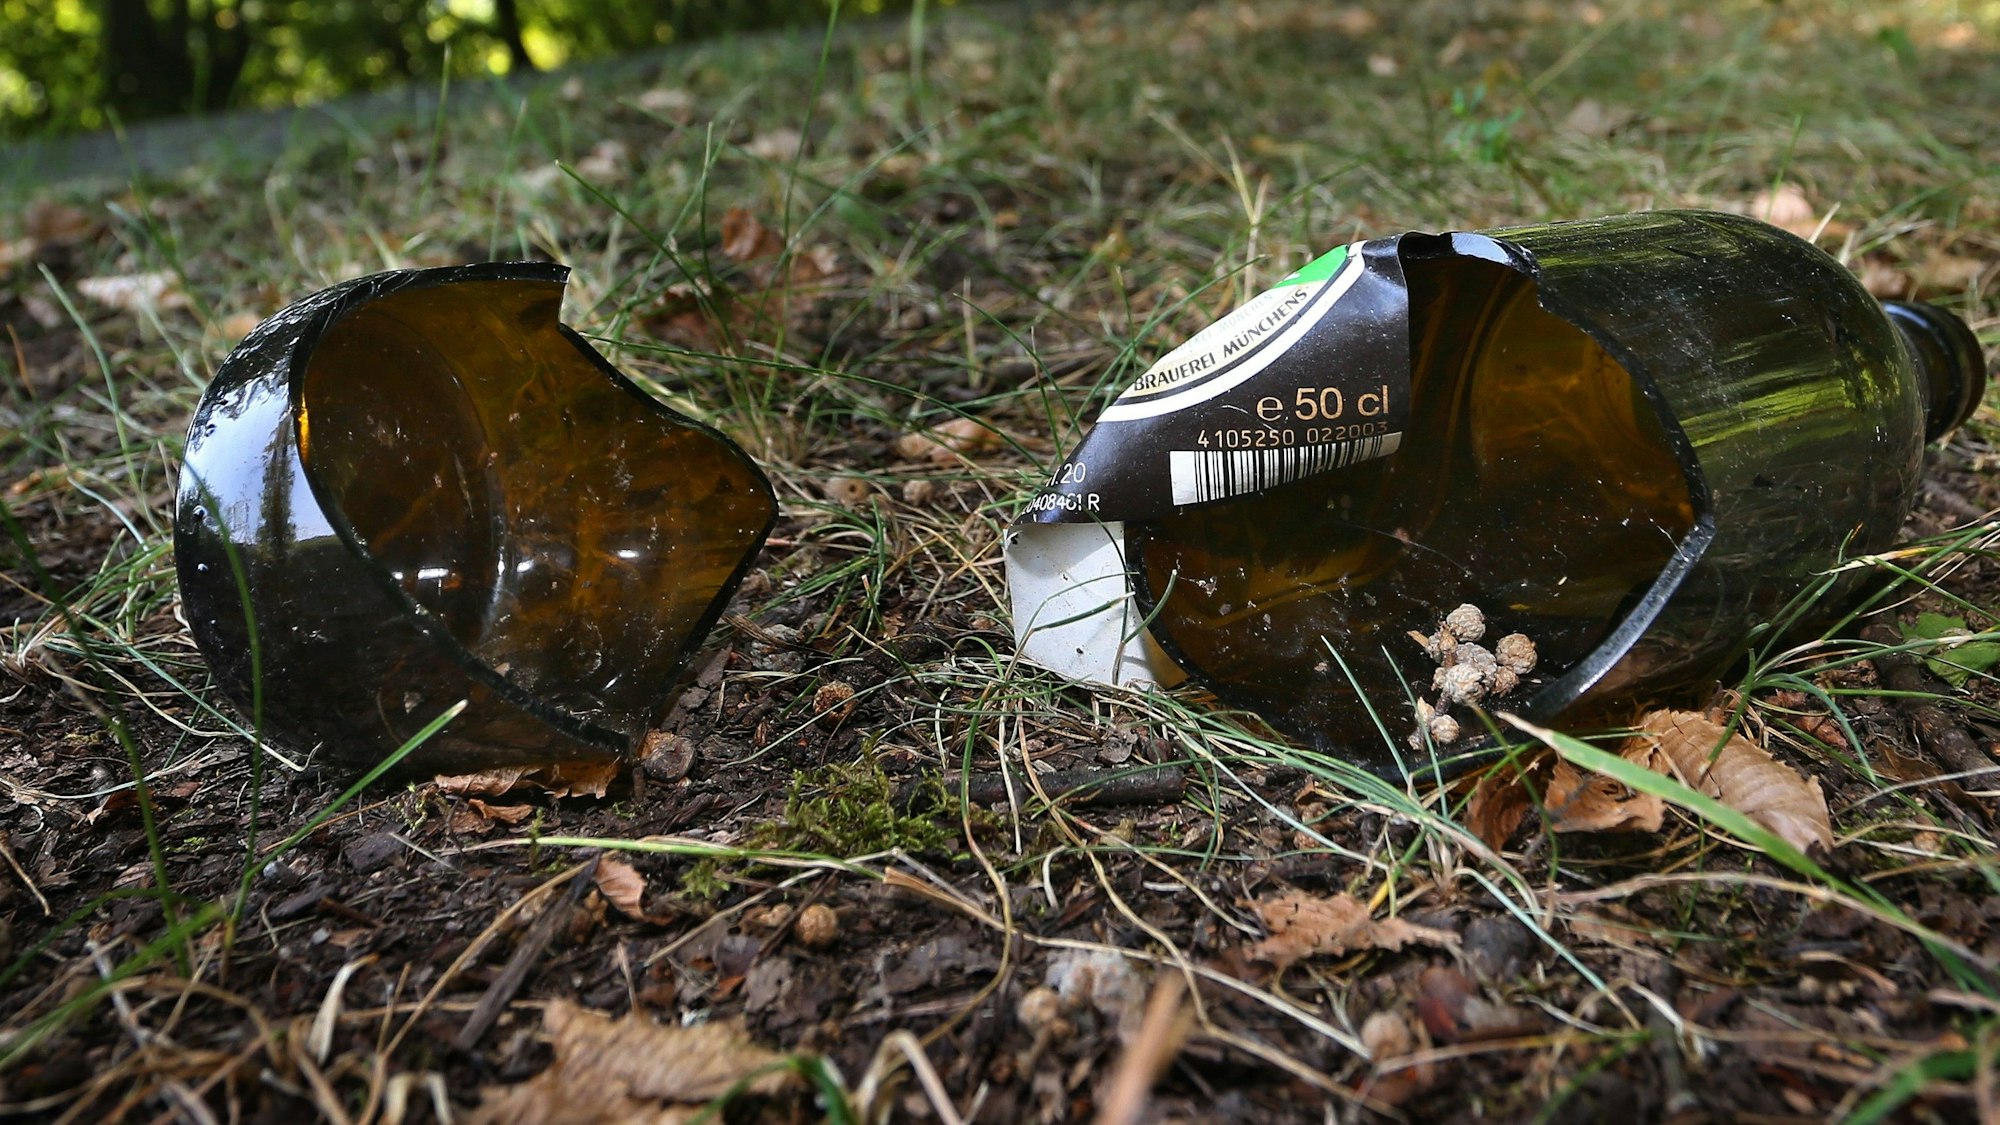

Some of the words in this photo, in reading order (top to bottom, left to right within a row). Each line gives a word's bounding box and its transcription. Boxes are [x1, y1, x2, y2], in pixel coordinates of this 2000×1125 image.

[1133, 353, 1216, 392] BRAUEREI
[1223, 289, 1308, 359] MÜNCHENS
[1295, 386, 1344, 421] 50
[1357, 384, 1390, 417] cl
[1306, 421, 1389, 444] 022003
[1087, 492, 1101, 512] R
